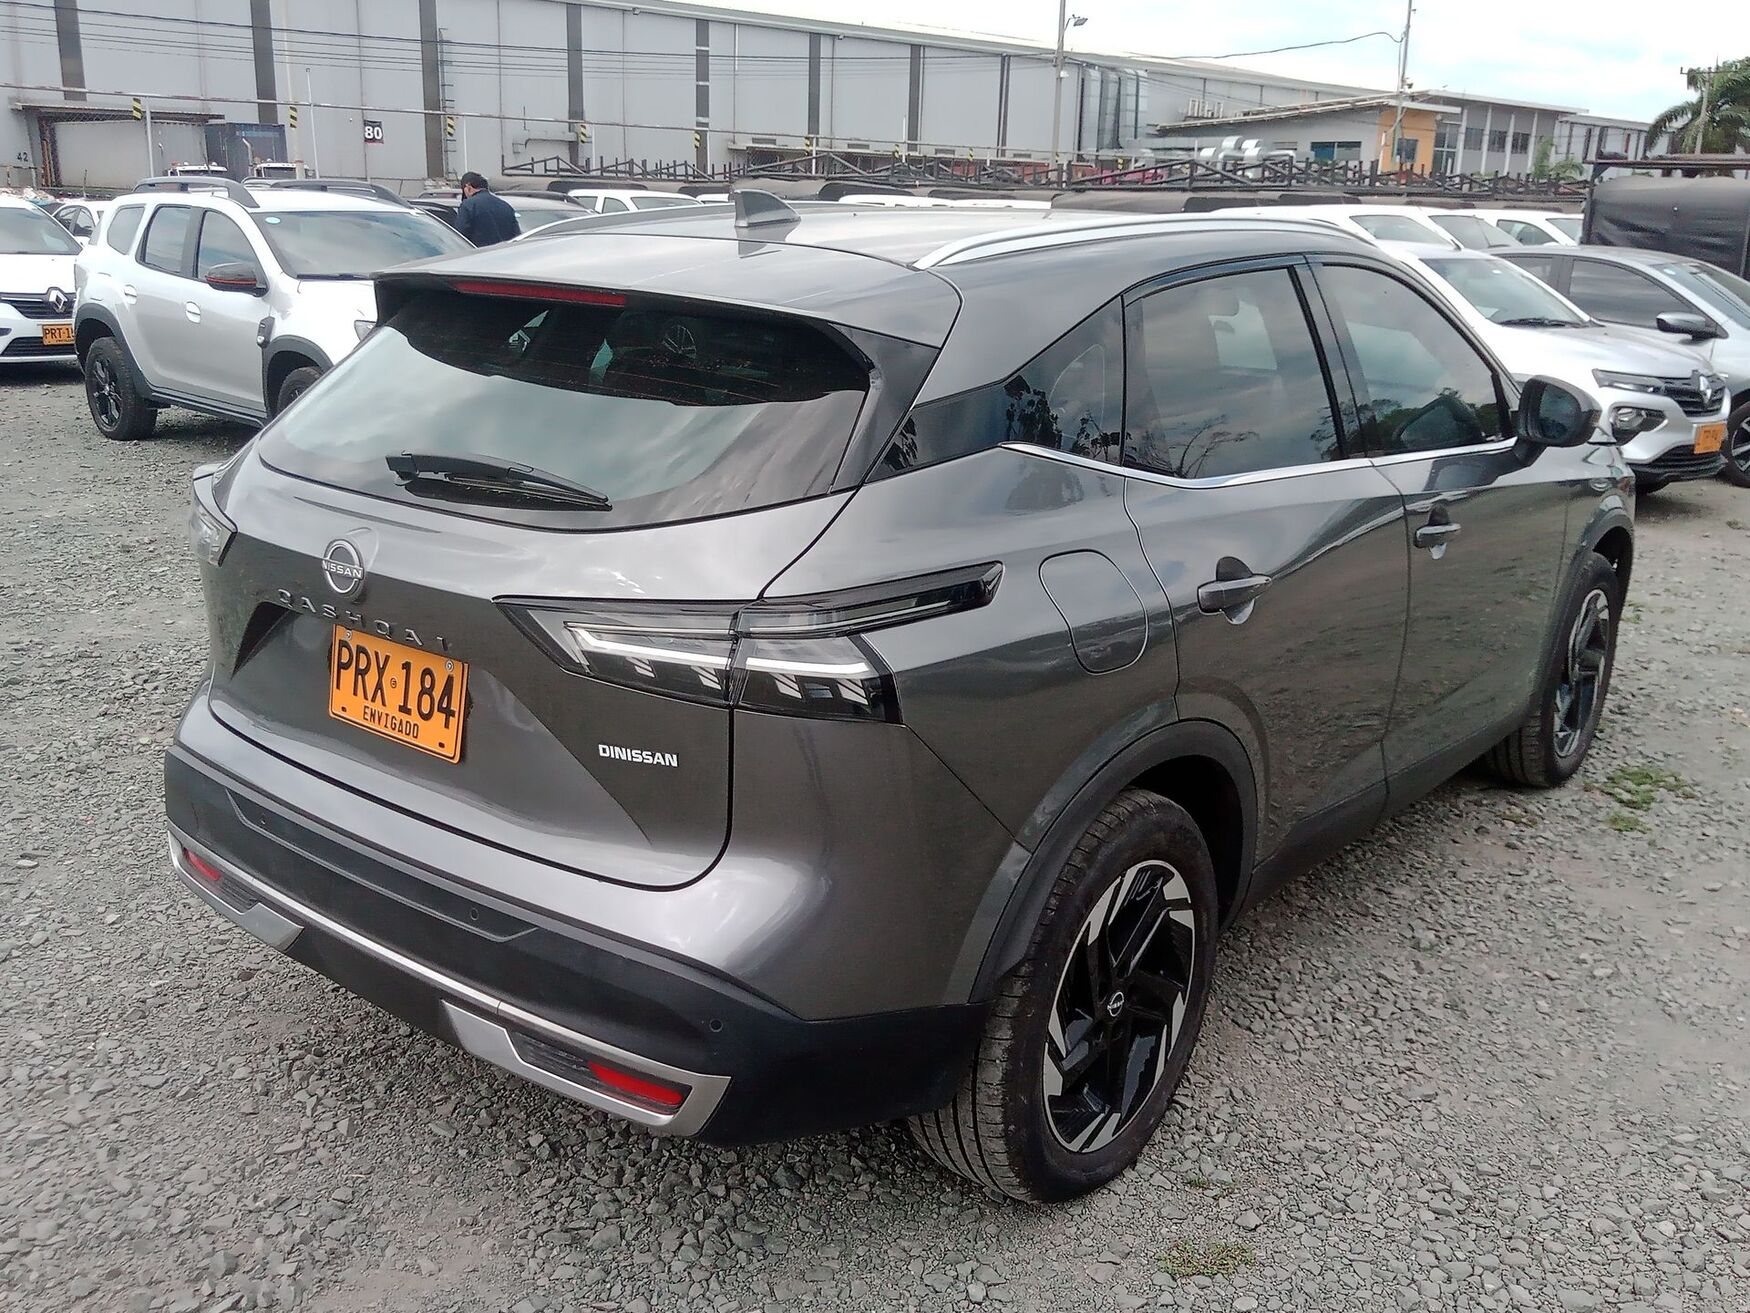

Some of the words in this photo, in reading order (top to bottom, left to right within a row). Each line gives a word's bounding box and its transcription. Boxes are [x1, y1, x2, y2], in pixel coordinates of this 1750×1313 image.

[365, 126, 382, 139] 80
[17, 152, 28, 162] 42
[322, 560, 362, 578] NISSAN
[277, 588, 448, 650] QASHQAI
[336, 639, 390, 707] PRX
[398, 661, 456, 729] 184
[363, 705, 420, 739] ENVIGADO
[598, 743, 678, 767] DINISSAN
